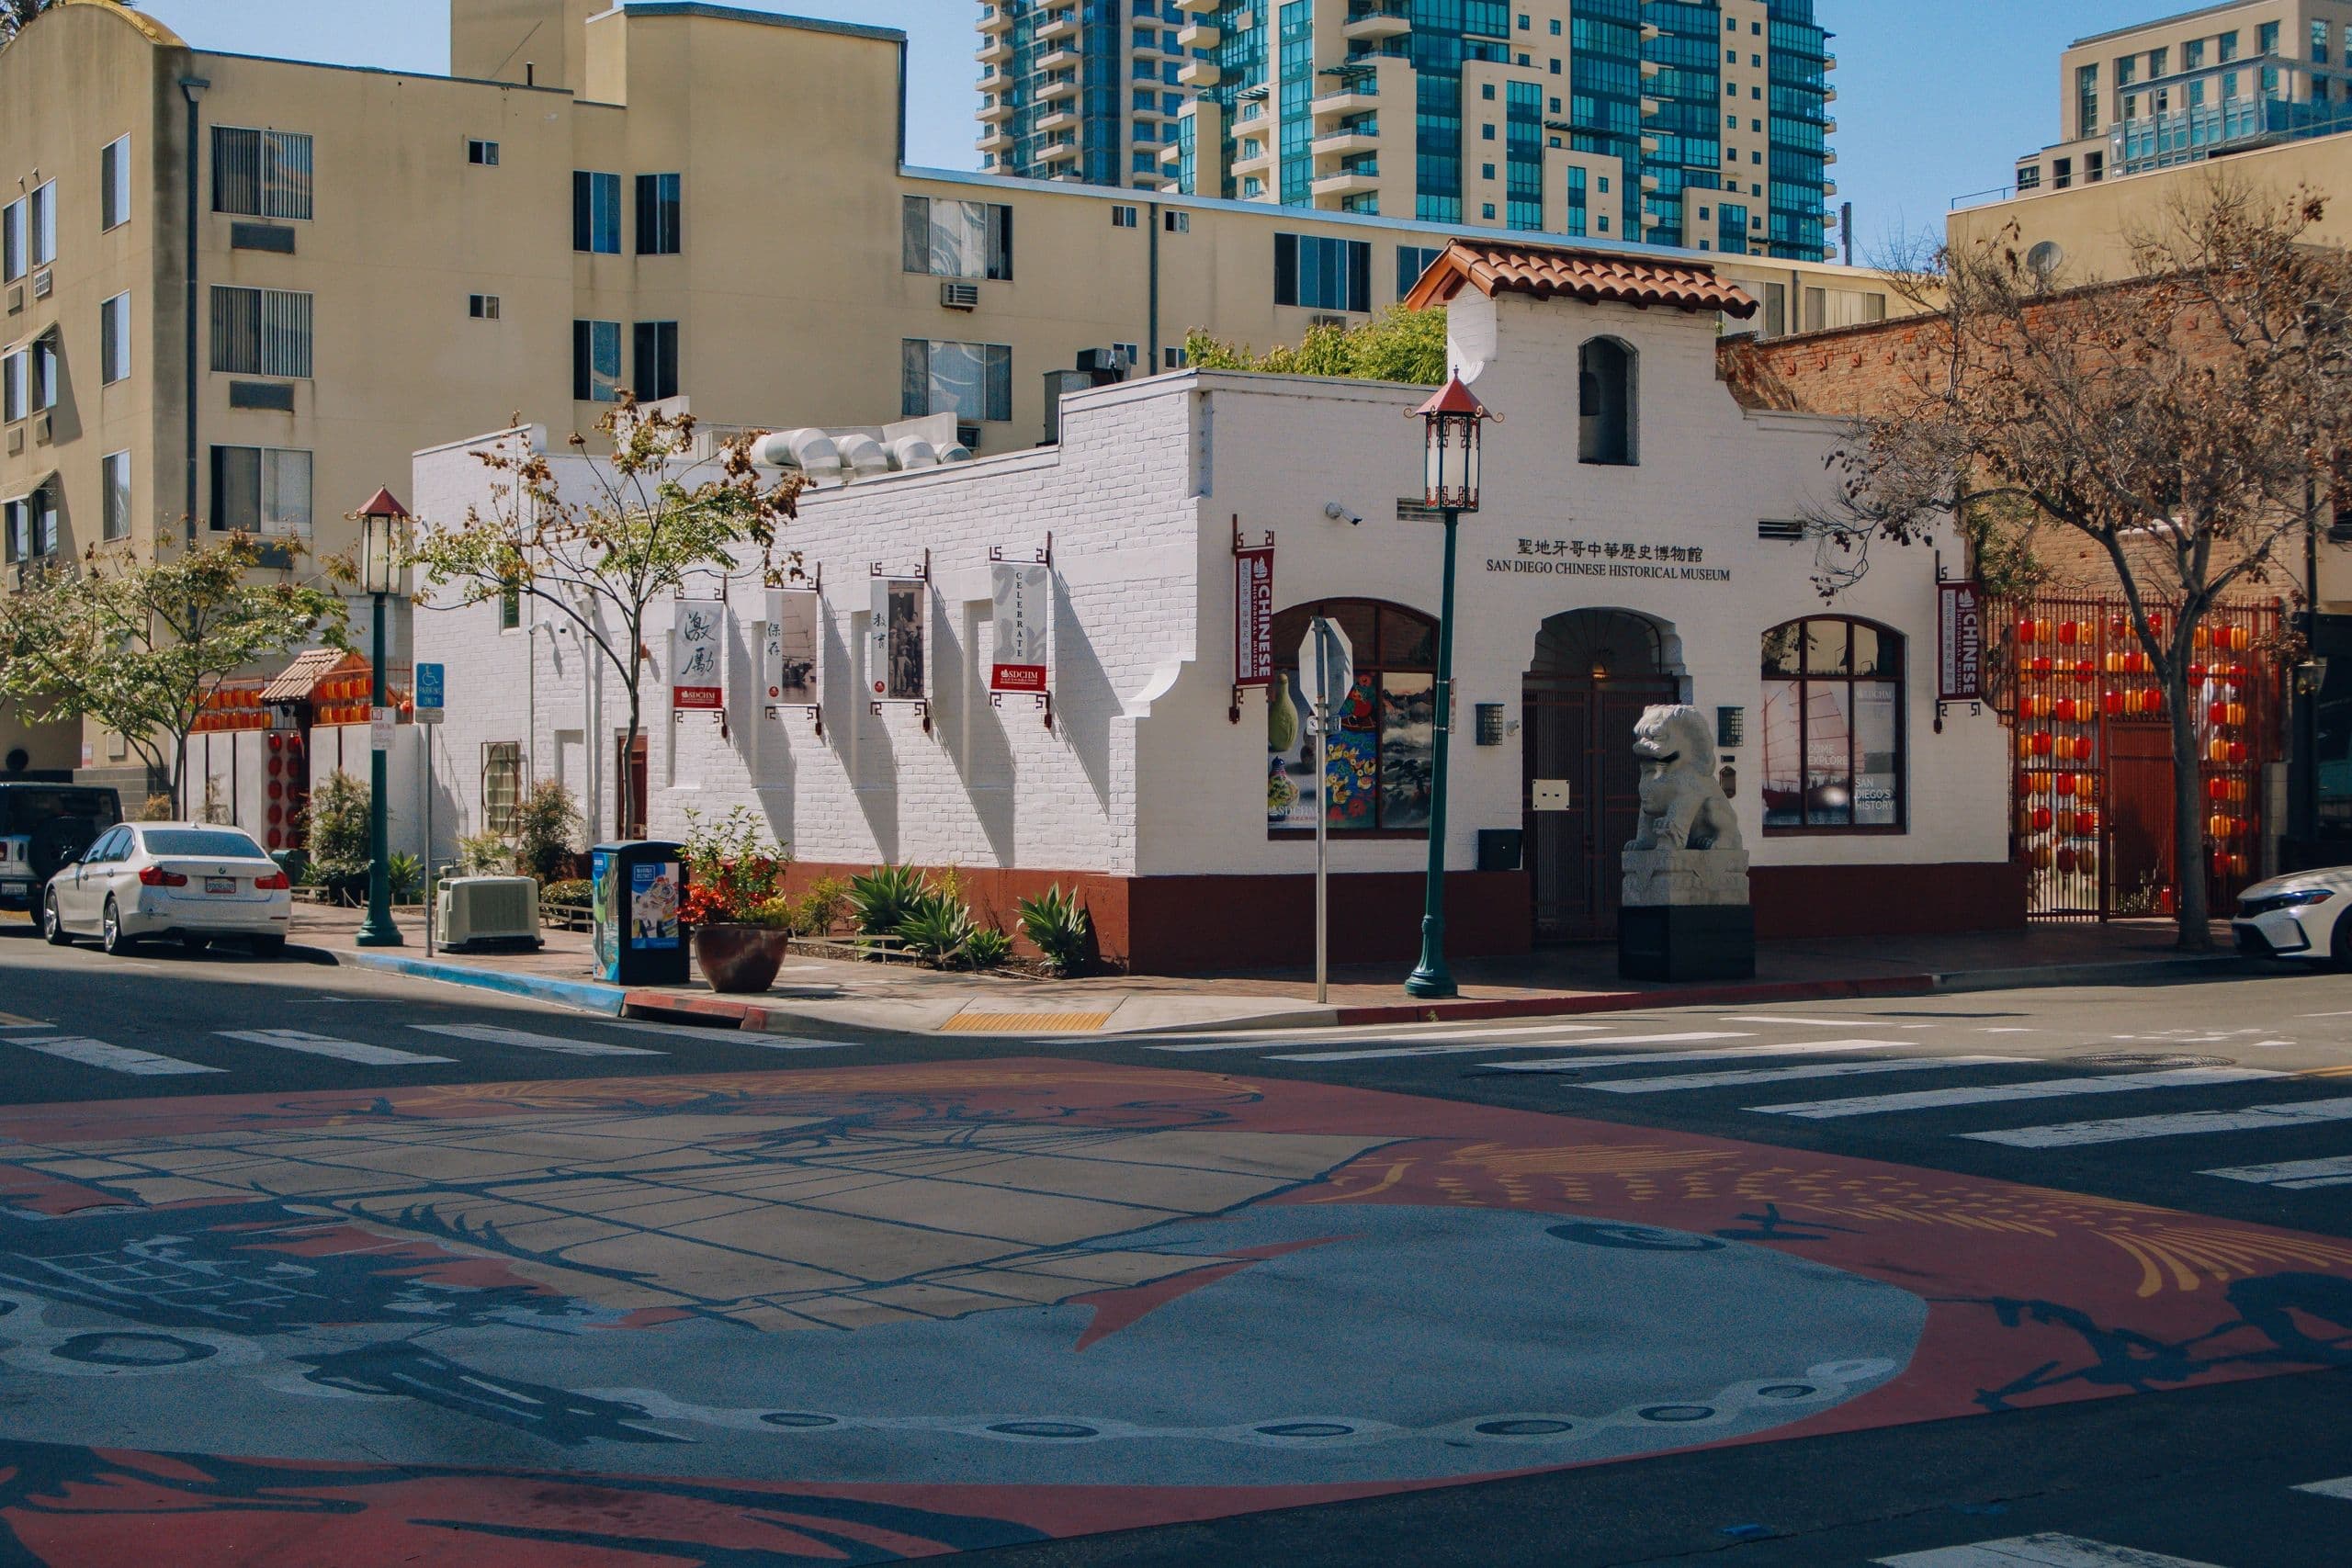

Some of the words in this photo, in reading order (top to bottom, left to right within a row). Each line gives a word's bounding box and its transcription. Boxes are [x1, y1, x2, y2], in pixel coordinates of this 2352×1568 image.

[1517, 538, 1703, 563] 聖地牙哥中華歷史博物館
[1487, 558, 1511, 572] SAN
[1514, 560, 1553, 574] DIEGO
[1555, 562, 1606, 577] CHINESE
[1609, 565, 1679, 580] HISTORICAL
[1680, 569, 1730, 581] MUSEUM
[1259, 585, 1271, 677] CHINESE
[682, 611, 716, 676] 激勵
[1963, 613, 1978, 694] CHINESE
[1008, 669, 1038, 680] SDCHM
[1807, 744, 1835, 754] COME
[1807, 755, 1849, 765] EXPLORE
[1855, 778, 1873, 787] SAN
[1855, 789, 1891, 799] DIEGO'S
[1855, 800, 1894, 810] HISTORY
